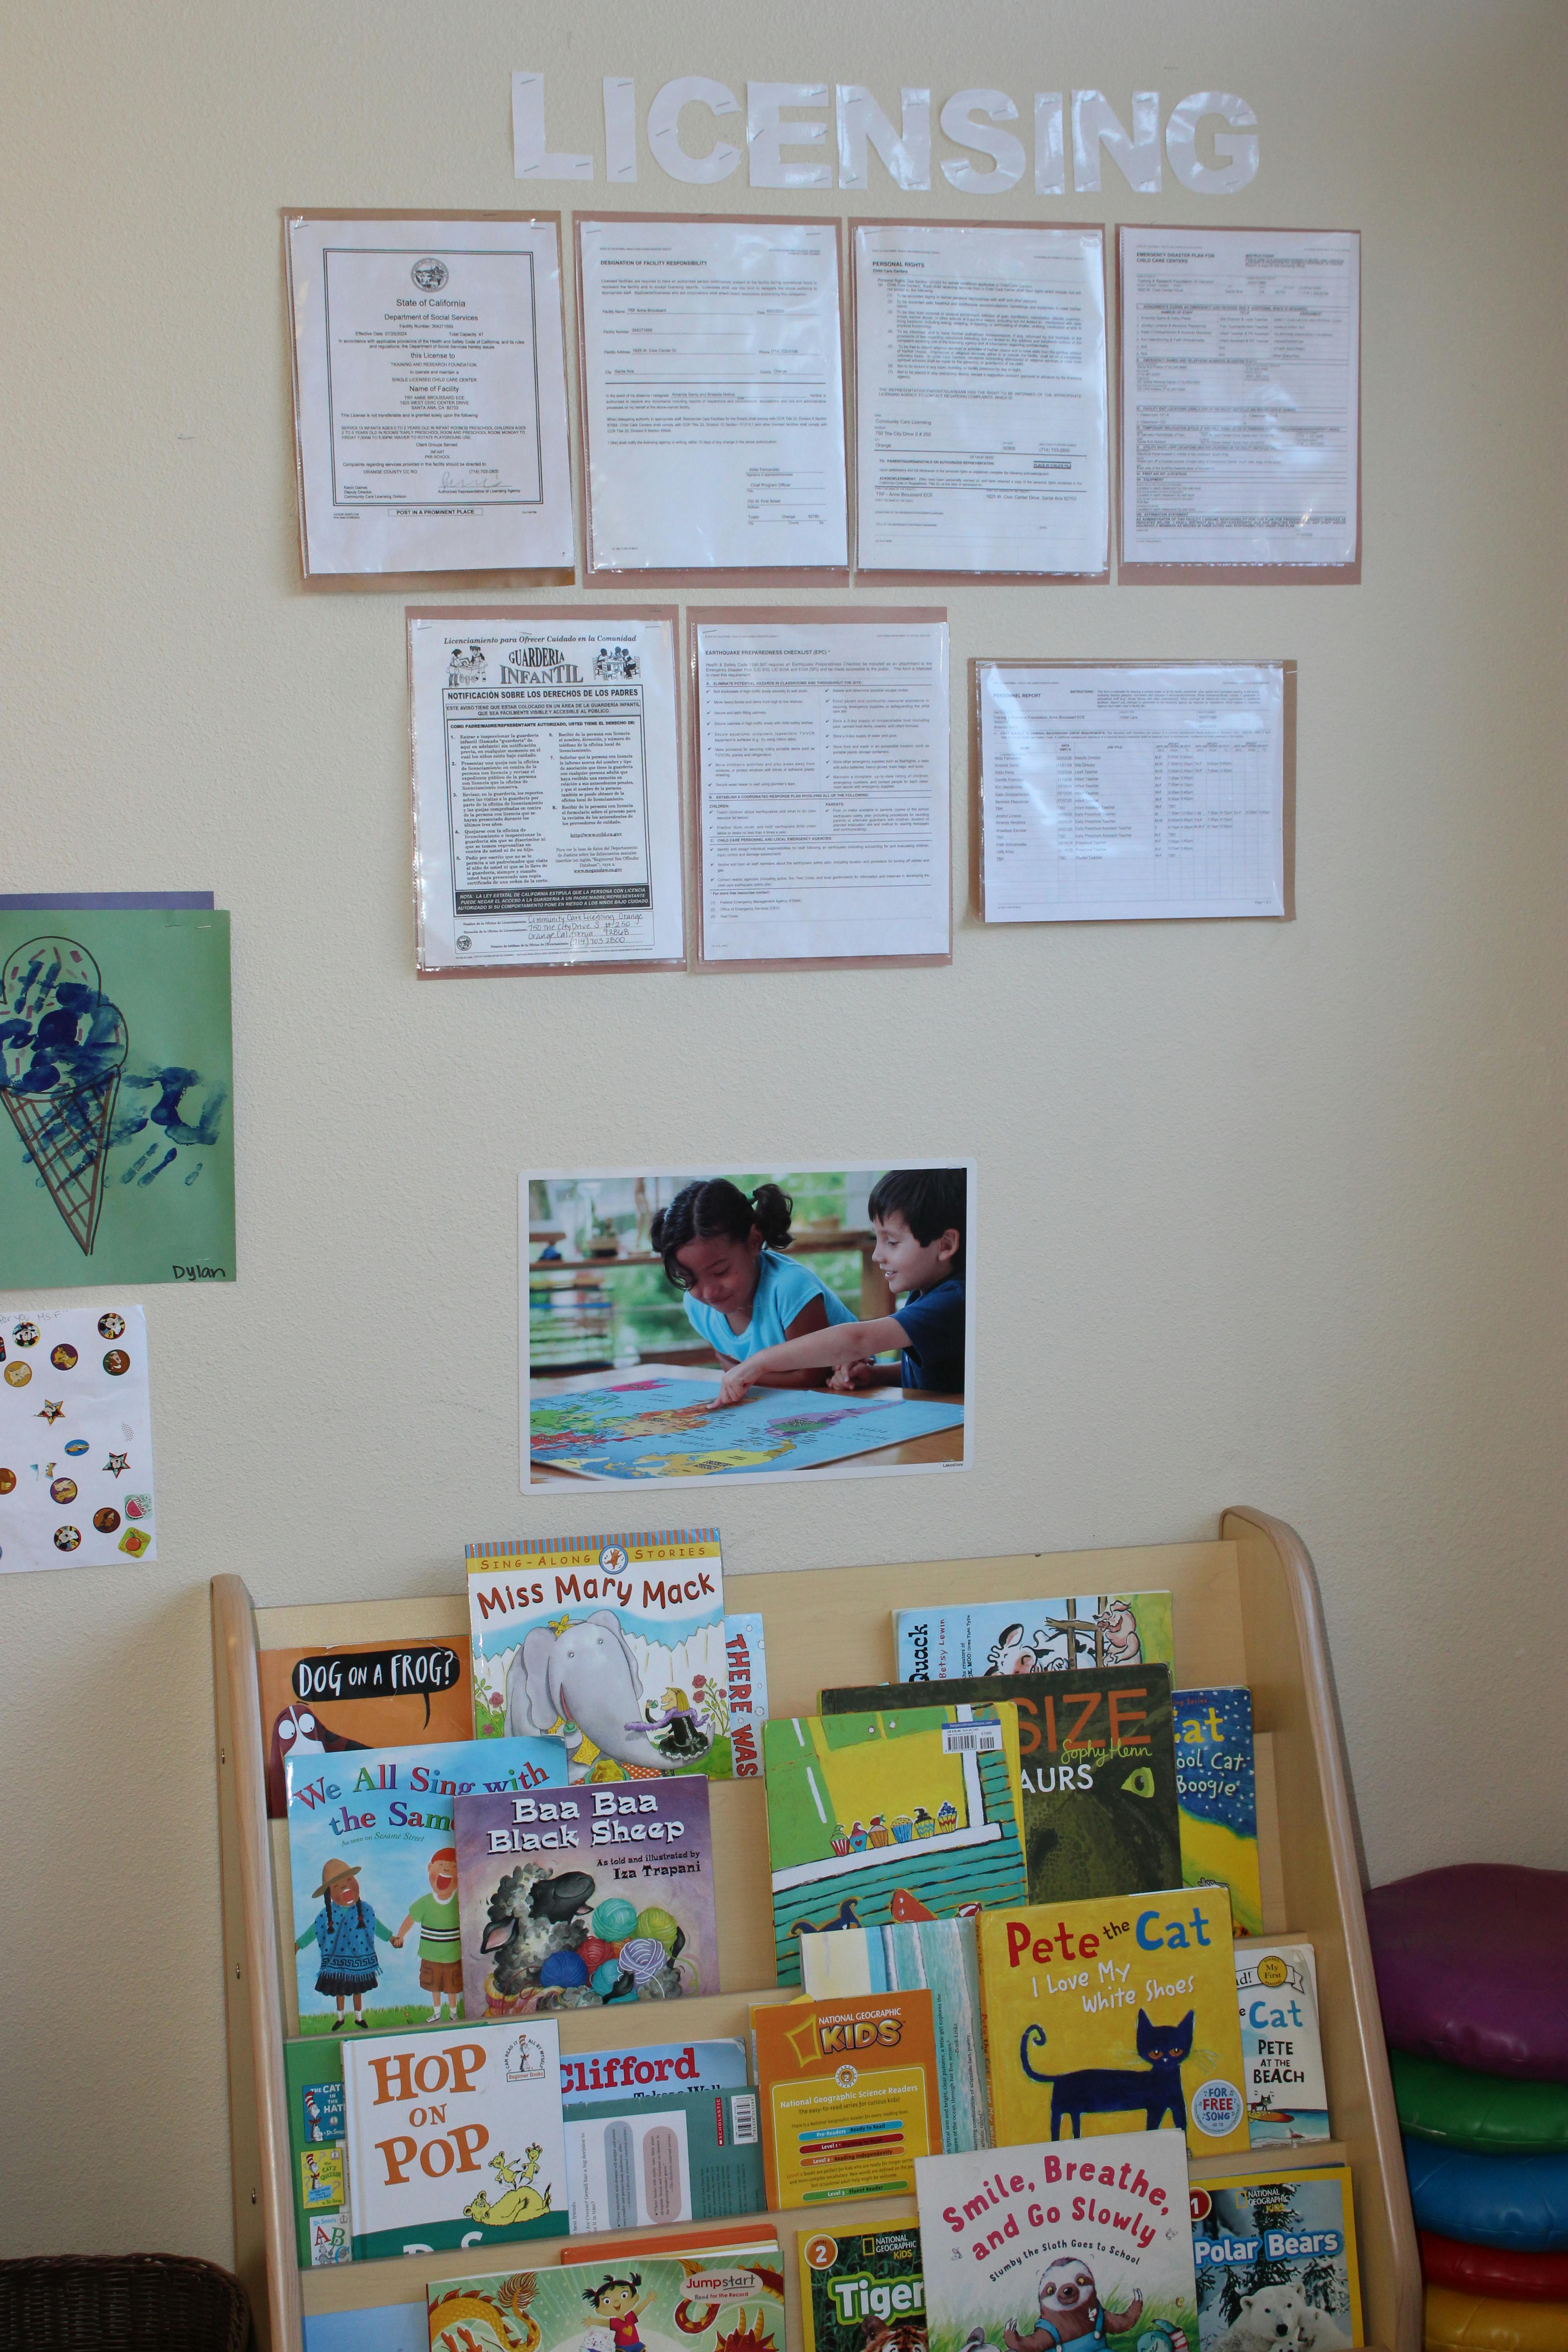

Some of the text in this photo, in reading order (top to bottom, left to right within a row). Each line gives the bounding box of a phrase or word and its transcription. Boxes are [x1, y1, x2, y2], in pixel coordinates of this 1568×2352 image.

[512, 71, 1259, 194] LICENSING
[429, 299, 466, 308] California
[508, 648, 565, 667] GUARDERIA
[500, 664, 584, 684] INFANTIL
[448, 689, 499, 700] NOTIFICACIÓN
[542, 690, 581, 698] DERECHOS
[619, 913, 644, 925] Orange
[172, 1265, 226, 1281] Dylan
[481, 1547, 706, 1570] SING-ALONG STORIES
[477, 1572, 715, 1619] Miss Mary Mack
[908, 1624, 929, 1682] Quack
[938, 1649, 948, 1679] Betsy
[299, 1650, 454, 1698] DOG ON A FROG?
[725, 1634, 758, 1777] THERE WAS
[1009, 1688, 1151, 1755] SIZE
[1061, 1737, 1152, 1767] Sophy Henn
[1211, 1752, 1244, 1771] Cat
[293, 1761, 550, 1810] We All Sing with
[1176, 1775, 1236, 1799] Boogie
[329, 1806, 376, 1835] the
[511, 1791, 659, 1825] Baa Baa
[487, 1819, 685, 1855] Black Sheep
[610, 1857, 626, 1865] told
[628, 1855, 643, 1863] and
[646, 1852, 688, 1861] illustrated
[690, 1851, 701, 1859] by
[613, 1861, 702, 1880] Iza Trapani
[1006, 1907, 1211, 1967] Pete the Cat
[1032, 1960, 1131, 1998] I Love My
[1082, 1975, 1194, 2013] White Shoes
[818, 2007, 902, 2025] NATIONAL GEOGRAPHIC
[1249, 2000, 1303, 2030] Cat
[819, 2018, 903, 2054] KIDS
[1258, 2040, 1294, 2056] PETE
[368, 2043, 486, 2106] HOP
[560, 2047, 700, 2094] Clifford
[1253, 2069, 1305, 2084] BEACH
[1260, 2058, 1291, 2068] AT THE
[323, 2083, 341, 2093] CAT
[780, 2085, 918, 2108] National Geographic Science Readers
[1209, 2087, 1228, 2097] FOR
[323, 2104, 343, 2114] HAT
[408, 2103, 448, 2128] ON
[1203, 2098, 1233, 2111] FREE
[1205, 2111, 1230, 2121] SONG
[375, 2123, 489, 2186] POP
[942, 2155, 1169, 2232] Smile, Breathe,
[972, 2196, 1157, 2261] and Go Slowly
[989, 2239, 1140, 2283] Slumby the Sloth Goes to School
[1194, 2234, 1338, 2264] Polar Bears
[686, 2274, 755, 2290] Jumpstart
